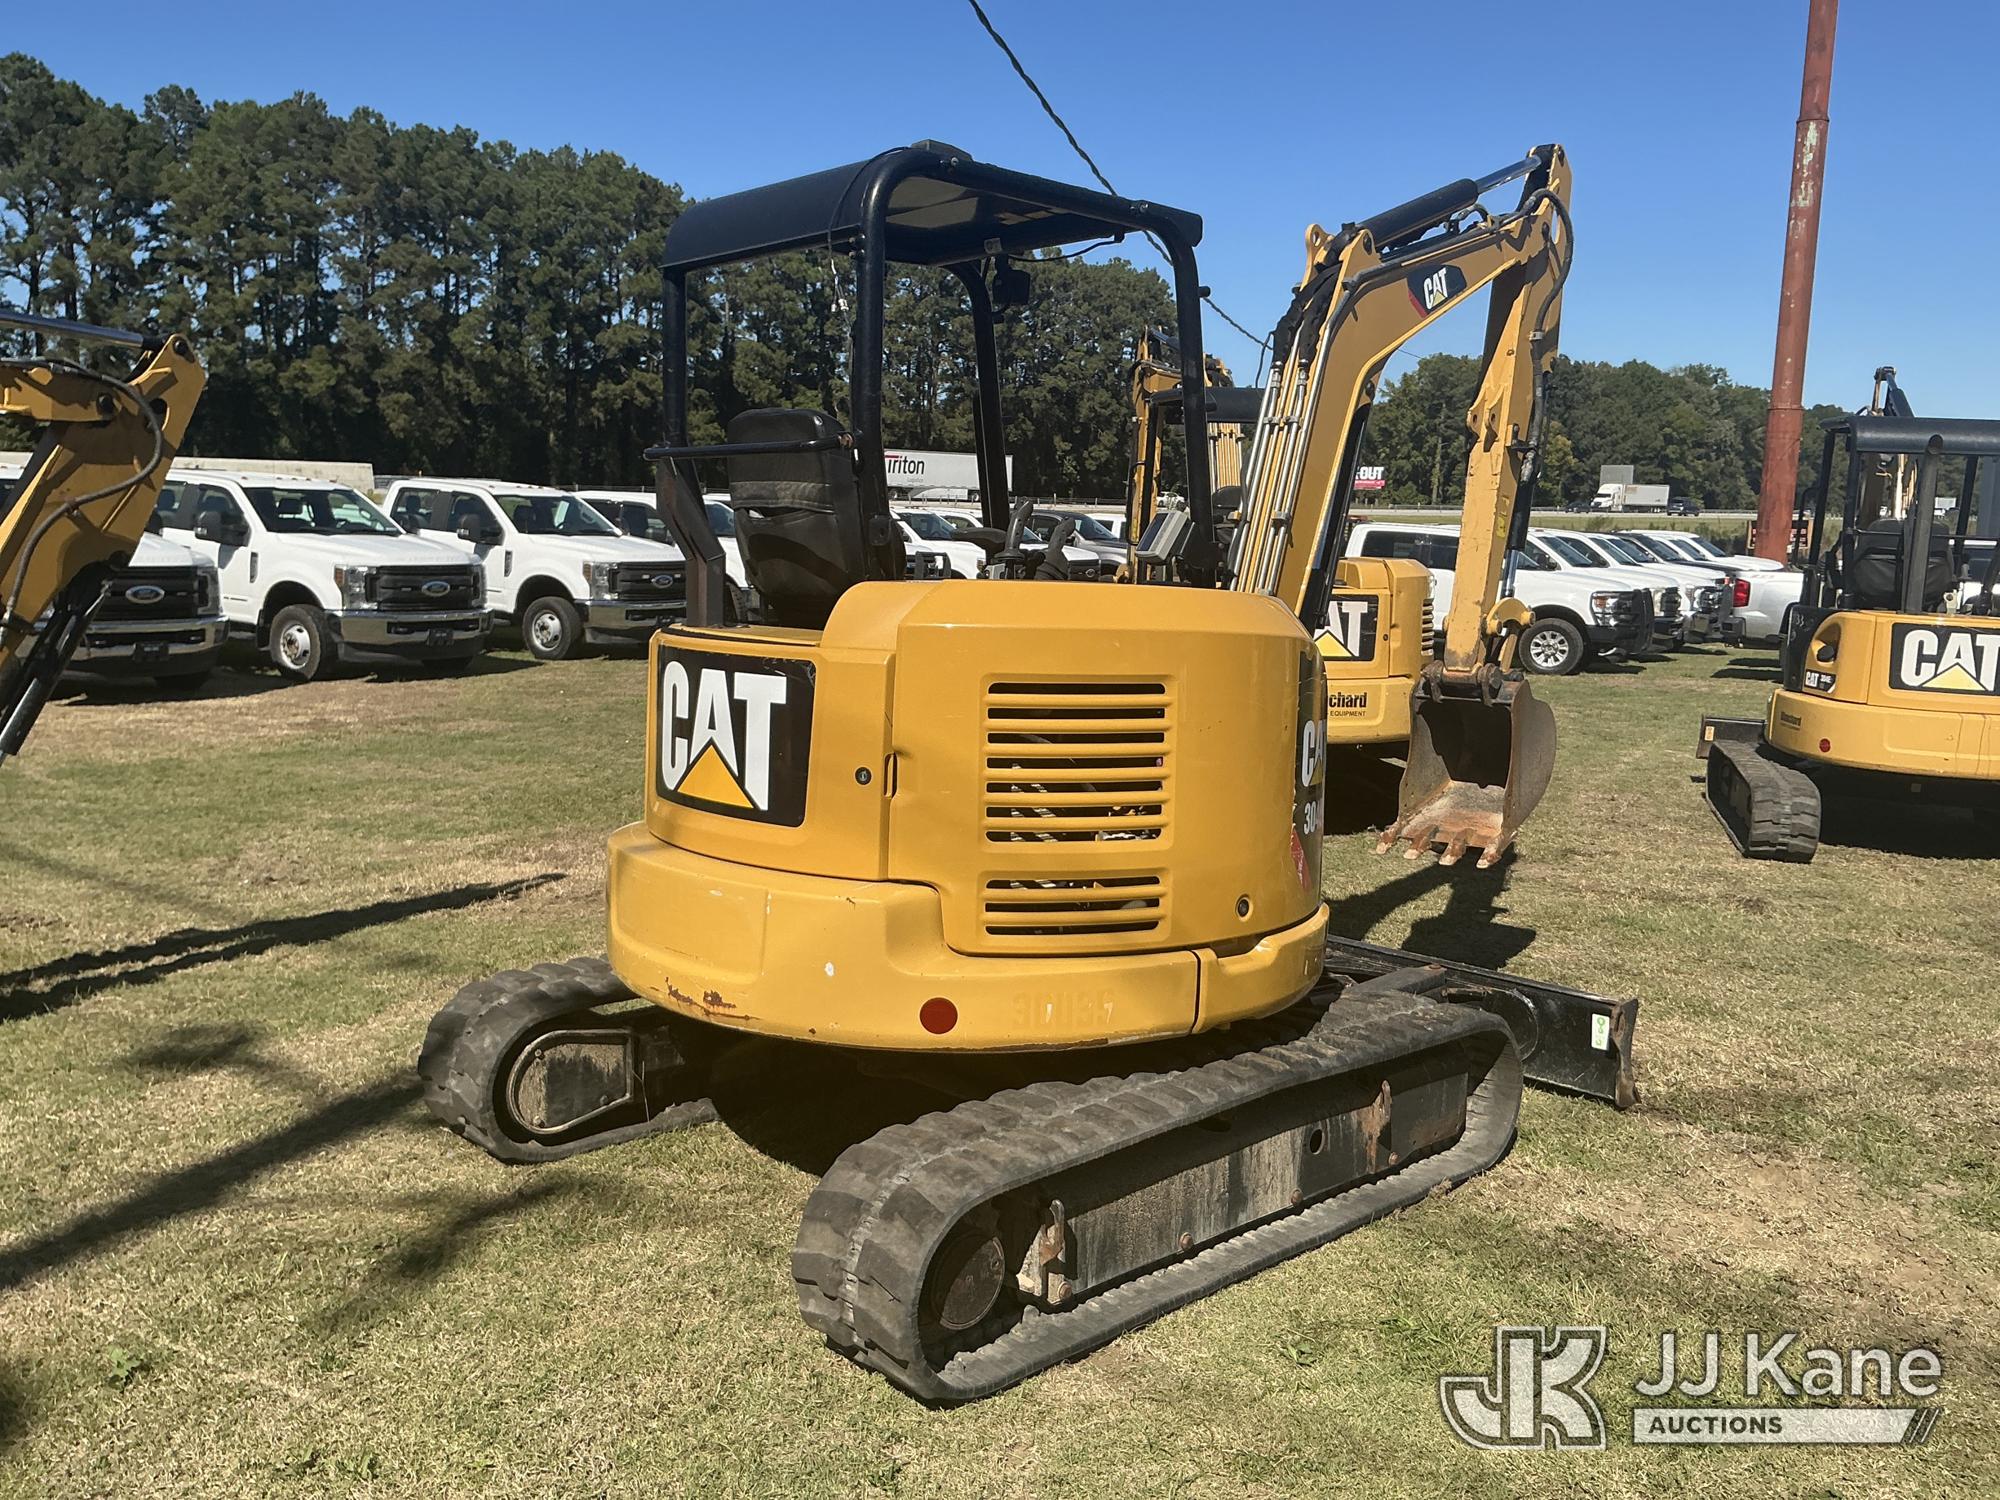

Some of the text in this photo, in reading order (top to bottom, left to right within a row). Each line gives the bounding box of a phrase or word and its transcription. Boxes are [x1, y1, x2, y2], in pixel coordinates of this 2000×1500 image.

[1424, 267, 1448, 309] CAT
[885, 455, 925, 475] Triton
[1805, 671, 1819, 688] CAT
[1901, 630, 2000, 692] CAT
[662, 661, 787, 811] CAT
